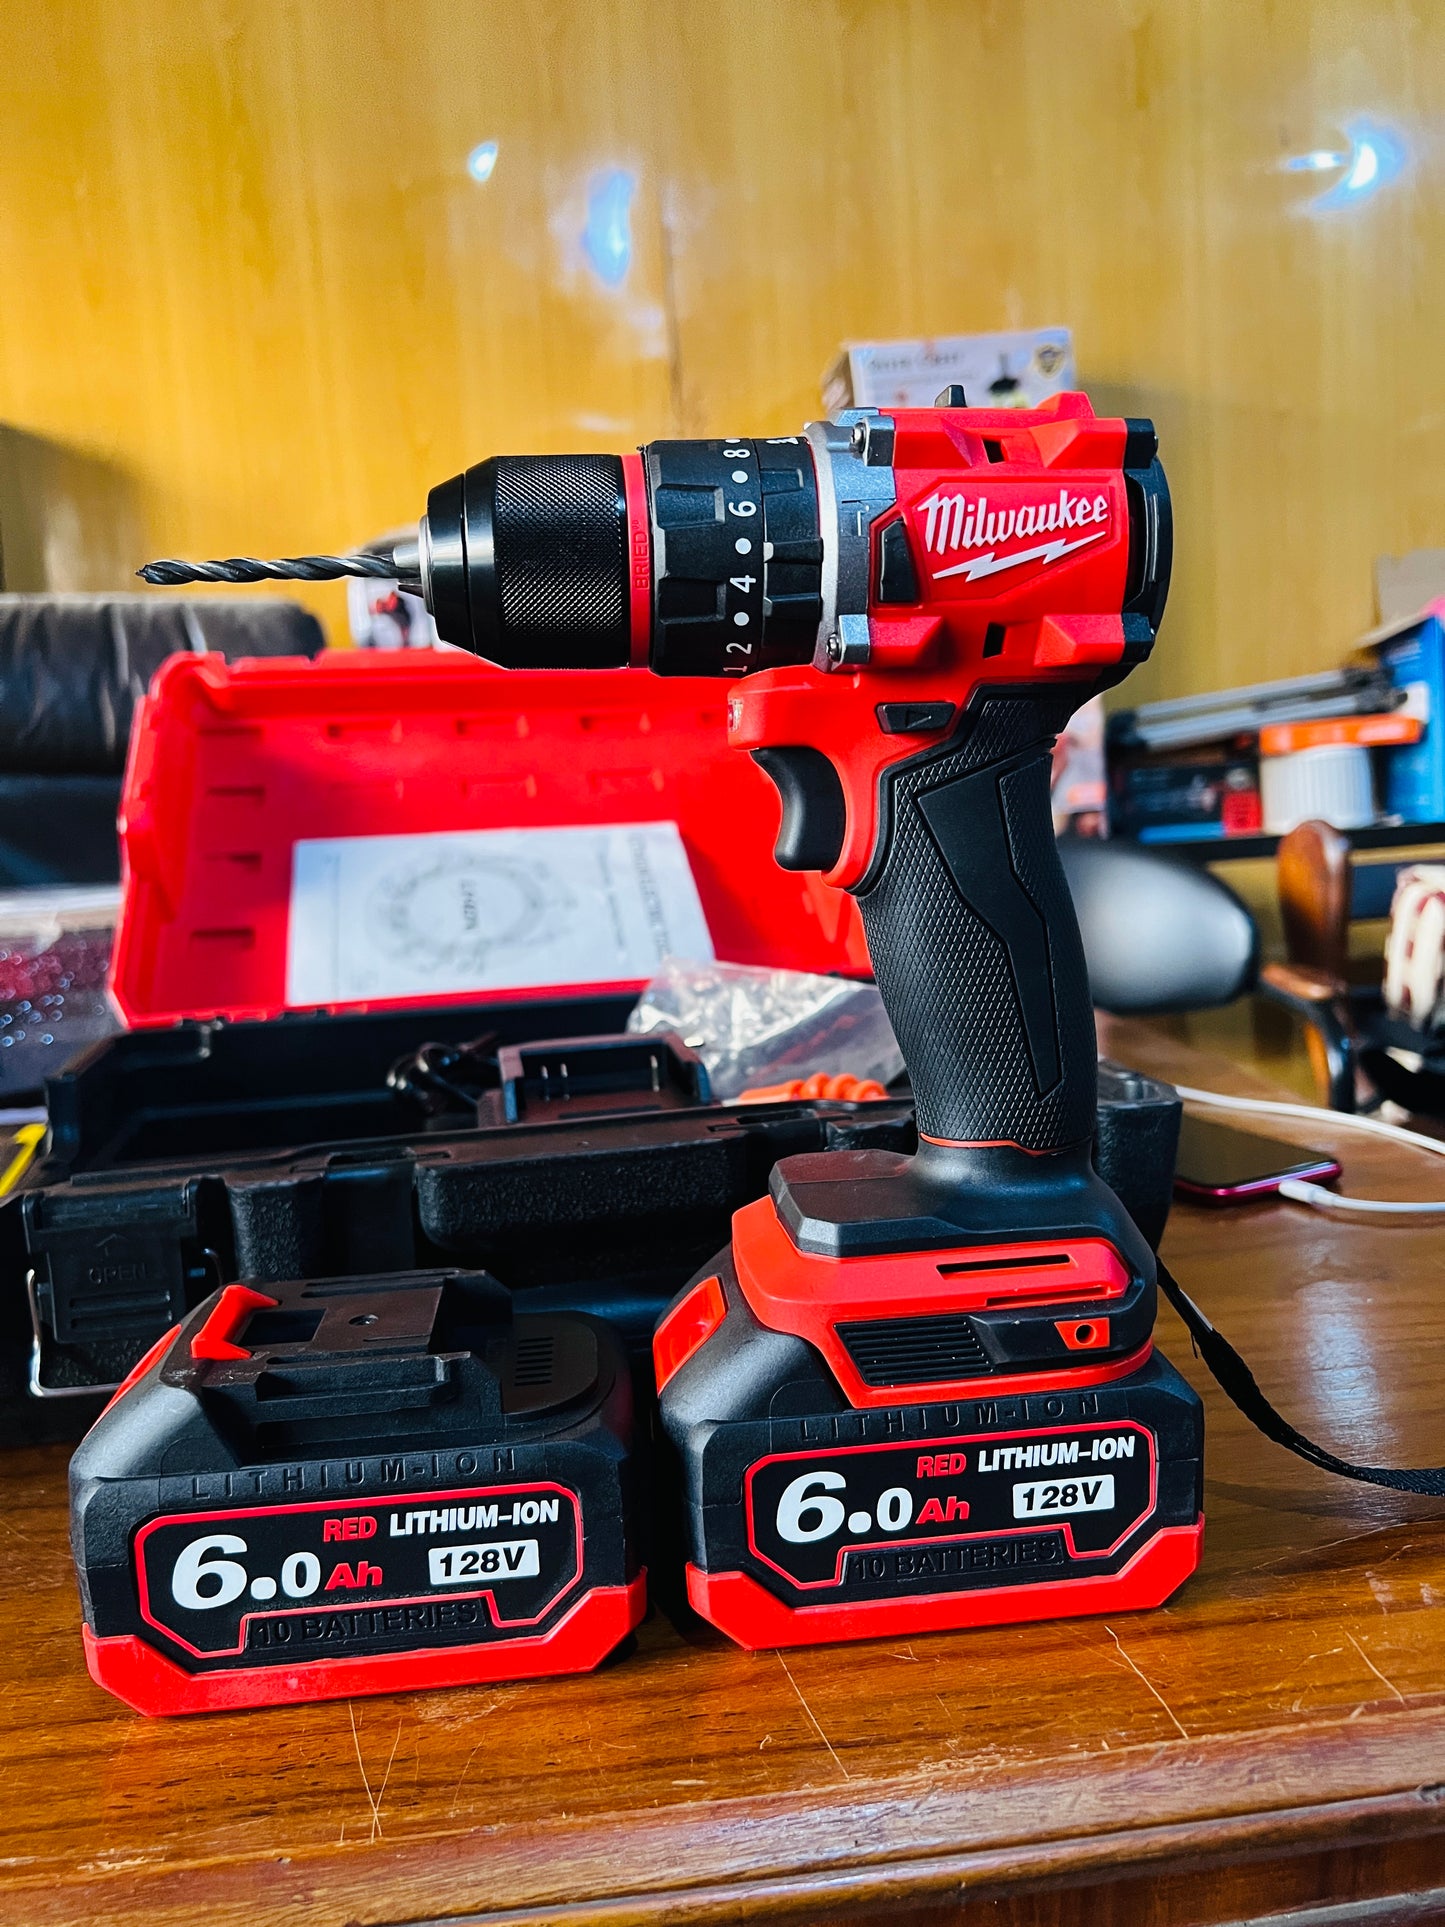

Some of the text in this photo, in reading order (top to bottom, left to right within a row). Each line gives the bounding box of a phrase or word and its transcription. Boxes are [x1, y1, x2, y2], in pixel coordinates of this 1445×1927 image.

[723, 448, 751, 459] 8
[728, 500, 757, 518] 6
[918, 489, 1108, 555] Milwaukee
[729, 574, 757, 594] 4
[725, 642, 753, 655] 2
[802, 1394, 1099, 1441] LITHIUM-ION
[192, 1448, 516, 1499] LITHIUM-ION
[916, 1436, 1135, 1479] RED LITHIUM-ION
[1022, 1479, 1105, 1512] 128V
[322, 1499, 560, 1543] RED LITHIUM-ION
[440, 1547, 526, 1578] 128V
[852, 1537, 1059, 1580] 10 BATTERIES
[256, 1602, 479, 1645] 10 BATTERIES
